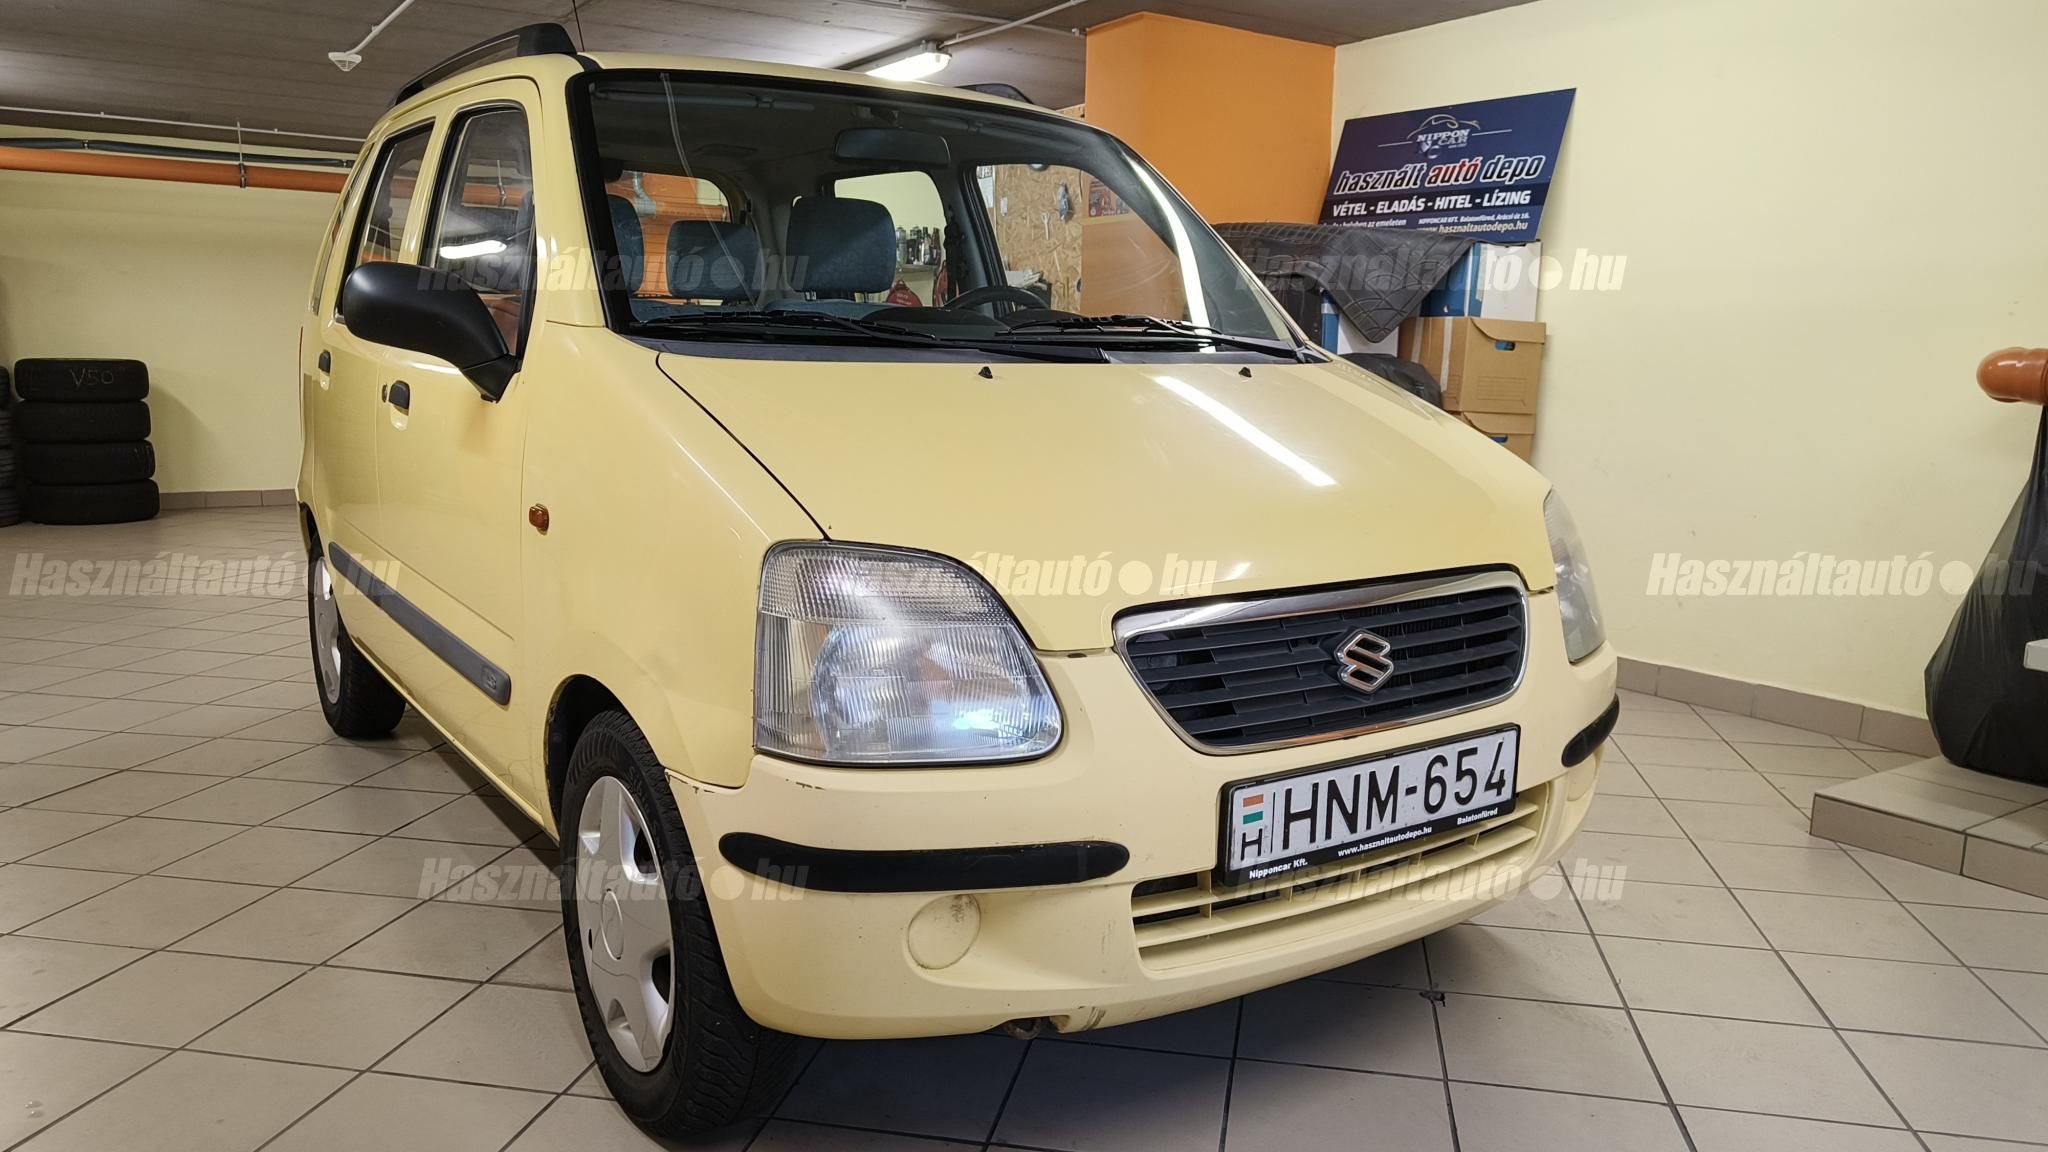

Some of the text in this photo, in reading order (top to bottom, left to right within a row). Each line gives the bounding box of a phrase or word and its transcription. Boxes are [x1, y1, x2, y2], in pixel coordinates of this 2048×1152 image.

[1416, 129, 1470, 142] NIPPON
[1438, 136, 1468, 145] CAR
[1334, 155, 1546, 195] használt autó depo
[1333, 201, 1368, 217] VÉTEL
[1376, 196, 1426, 214] ELADÁS
[1434, 194, 1472, 210] HITEL
[1482, 190, 1531, 207] LÍZING
[1282, 741, 1506, 850] HNM-654
[1241, 828, 1263, 861] H
[1338, 807, 1499, 857] www.hasznaltautodepo.hu Balatonfüred
[1249, 858, 1308, 879] Nipponcar Kft.
